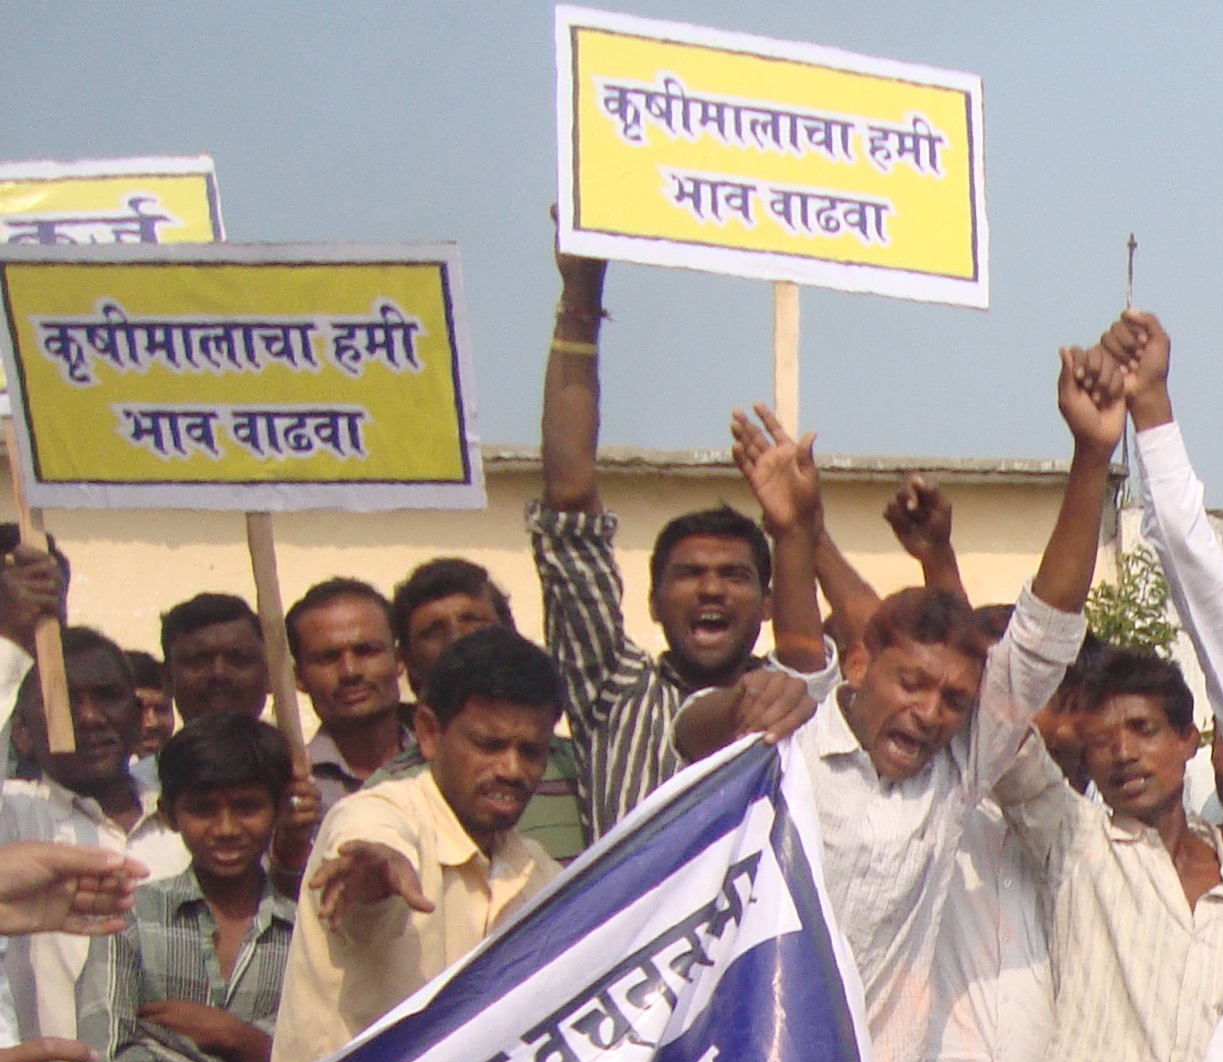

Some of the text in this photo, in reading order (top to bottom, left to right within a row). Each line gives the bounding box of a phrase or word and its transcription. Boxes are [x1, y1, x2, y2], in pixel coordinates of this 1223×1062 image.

[603, 77, 942, 174] कृषीमालाचा हमी
[672, 174, 889, 242] भाव वाढवा
[39, 304, 419, 382] कृषीमालाचा हमी
[123, 409, 365, 456] भाव वाढवा
